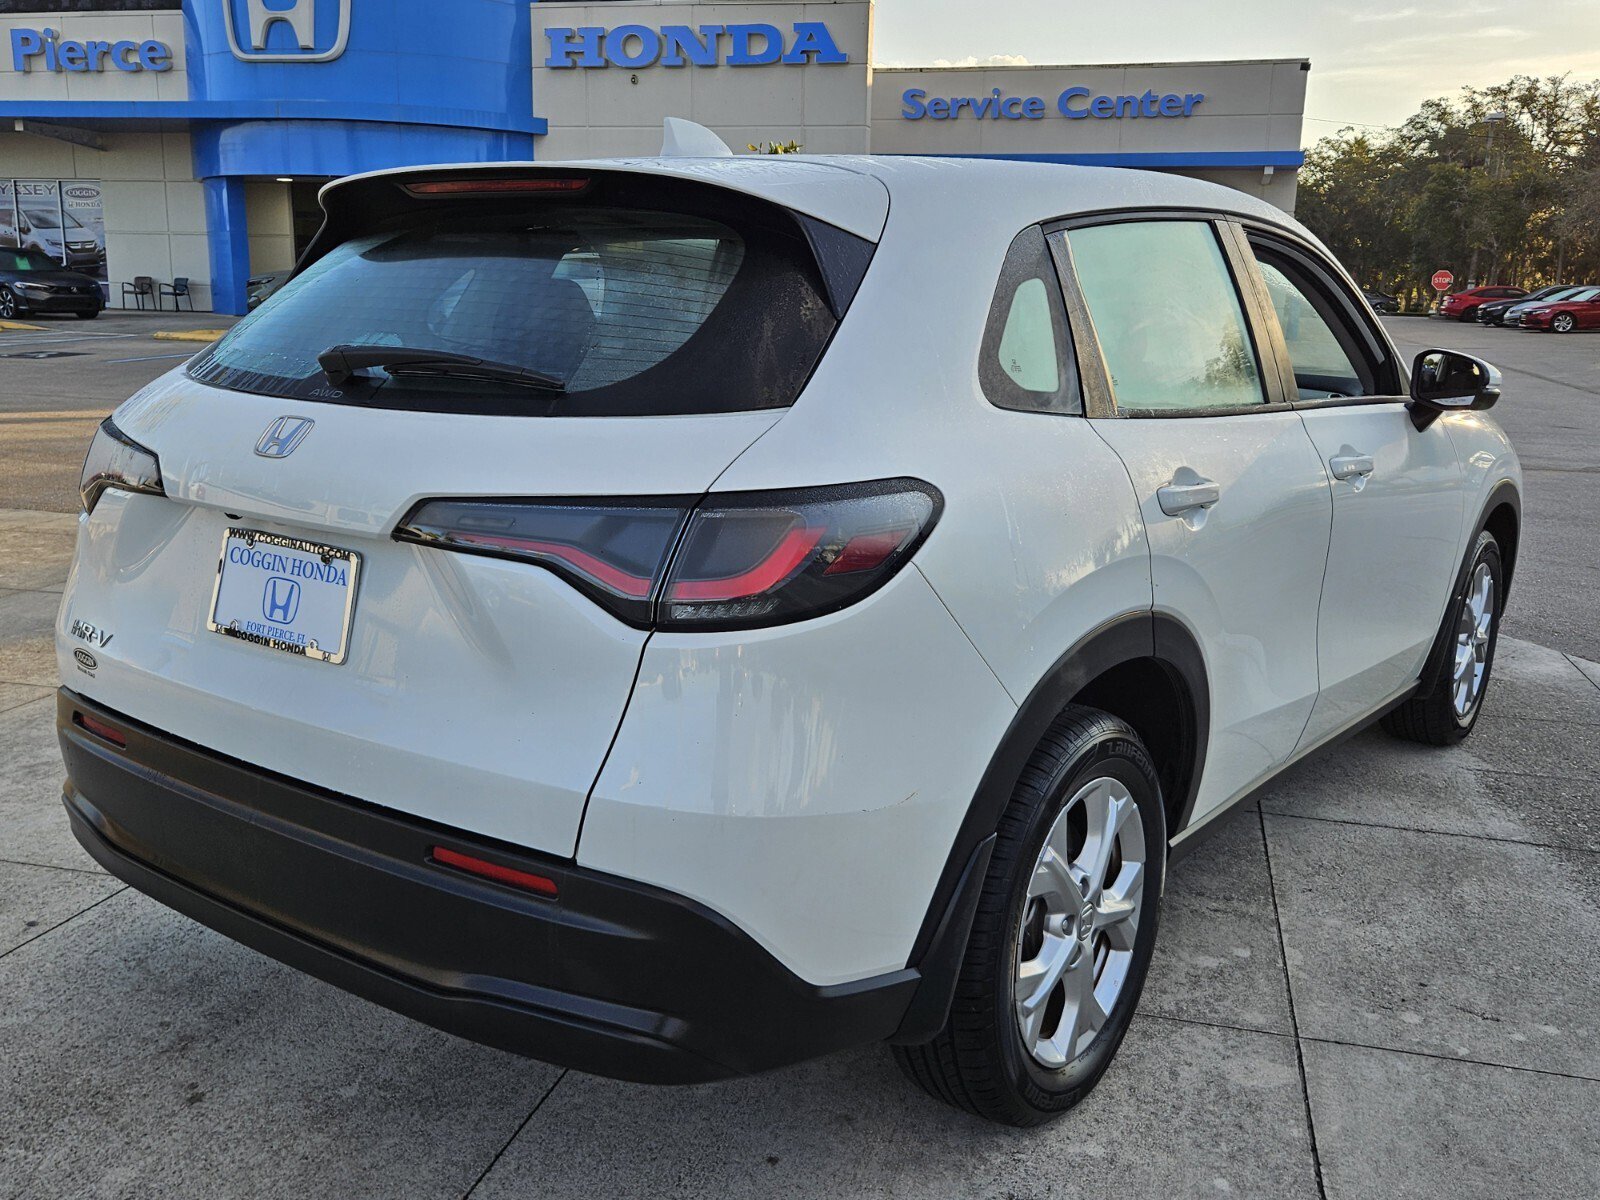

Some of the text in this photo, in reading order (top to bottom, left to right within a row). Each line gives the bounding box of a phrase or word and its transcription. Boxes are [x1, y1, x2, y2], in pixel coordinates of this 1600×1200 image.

[10, 28, 173, 73] Pierce
[545, 22, 848, 68] HONDA
[902, 86, 1205, 121] Service Center
[67, 189, 98, 197] COGGIN
[309, 389, 343, 398] AWD
[230, 546, 347, 587] COGGIN HONDA
[71, 619, 114, 648] HR-V
[235, 630, 307, 656] COGGIN HONDA
[246, 621, 266, 634] FORT
[297, 633, 306, 645] FL
